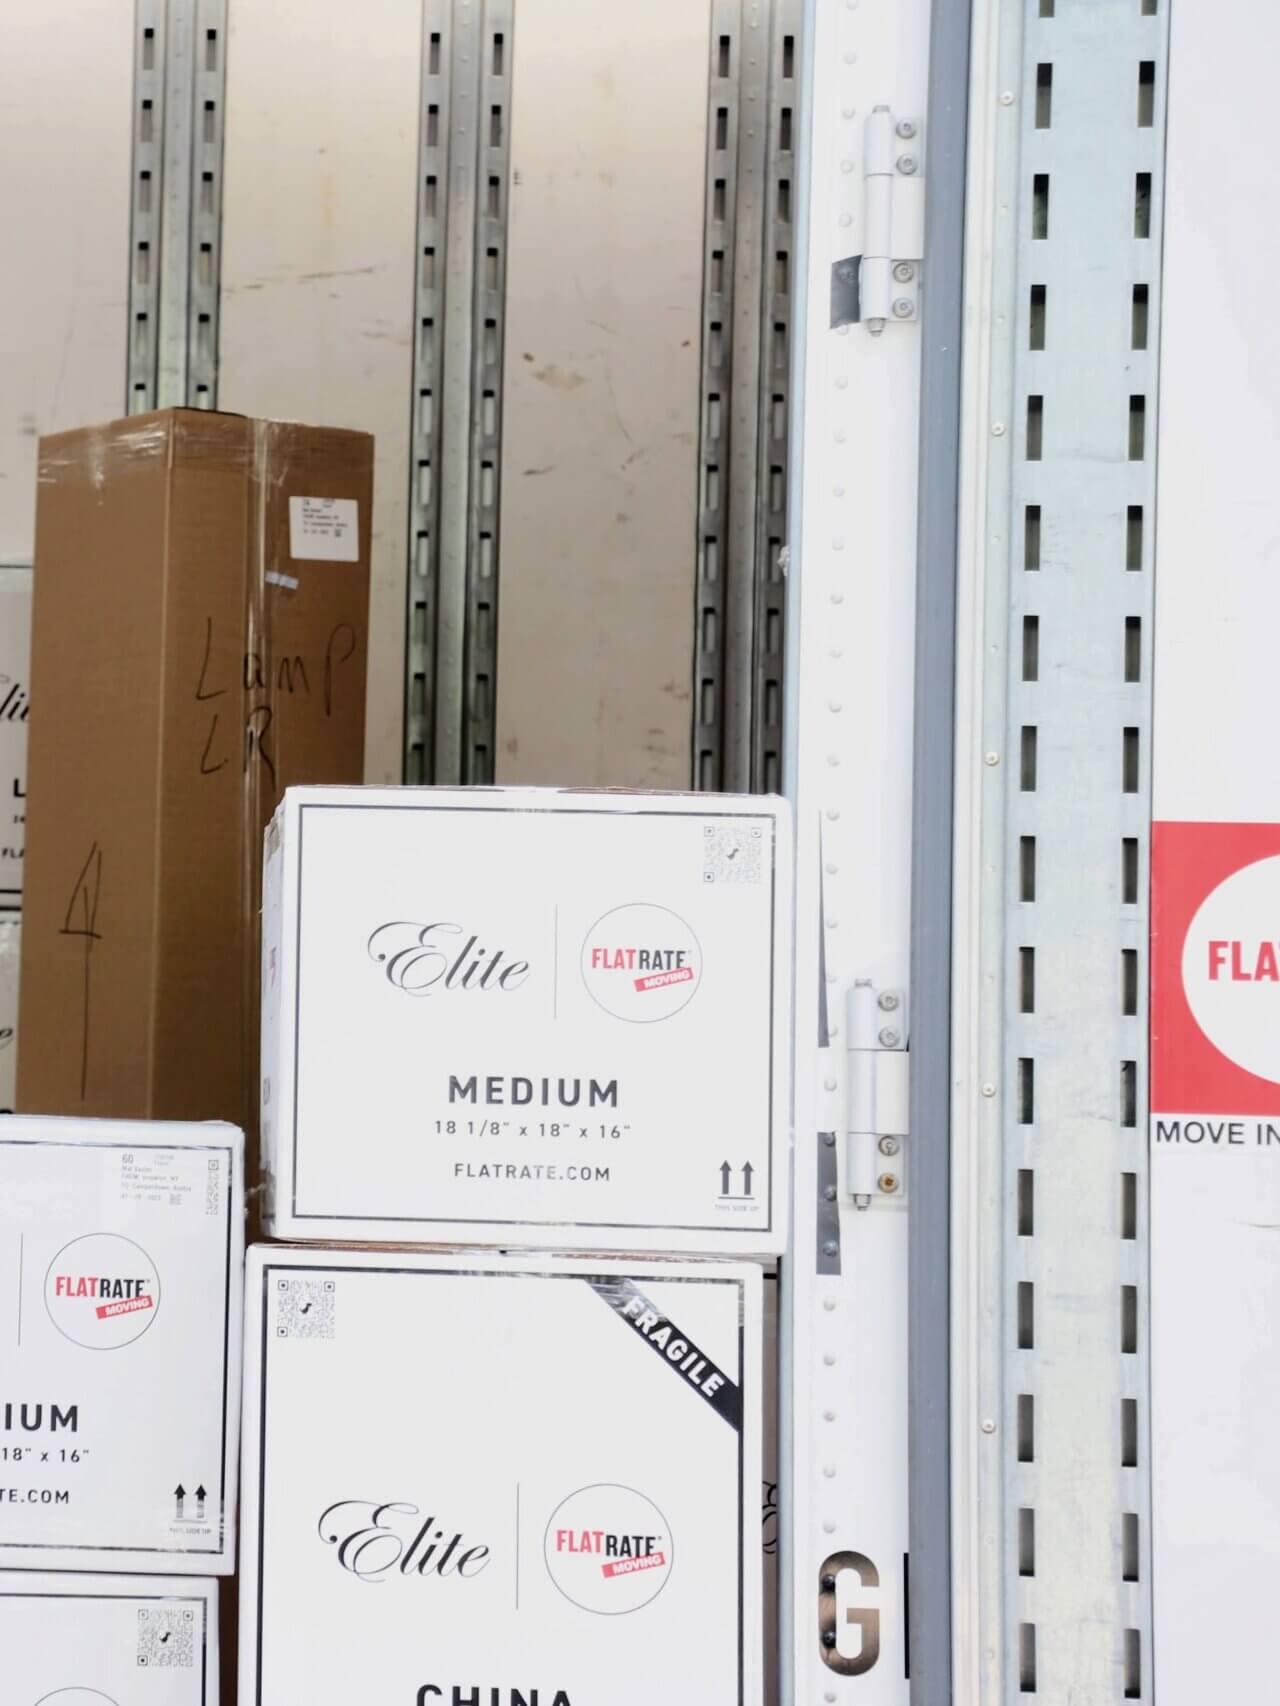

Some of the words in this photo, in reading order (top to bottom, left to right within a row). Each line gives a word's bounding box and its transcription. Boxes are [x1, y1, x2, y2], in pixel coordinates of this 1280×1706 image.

[367, 920, 531, 998] Elite
[591, 947, 687, 971] FLATRATE
[1208, 940, 1280, 983] FLA
[643, 969, 691, 989] MOVING
[448, 1074, 619, 1108] MEDIUM
[435, 1120, 457, 1135] 18
[467, 1119, 510, 1137] 1/8"
[519, 1127, 528, 1137] x
[539, 1122, 570, 1138] 18"
[579, 1128, 588, 1138] x
[599, 1124, 631, 1139] 16"
[1156, 1120, 1246, 1145] MOVE
[454, 1162, 610, 1182] FLATRATE.COM
[55, 1275, 145, 1299] FLATRATE
[105, 1297, 150, 1316] MOVING
[621, 1296, 725, 1398] FRAGILE
[1, 1447, 32, 1462] 18"
[40, 1451, 49, 1462] x
[59, 1448, 90, 1464] 16"
[318, 1500, 493, 1584] Elite
[556, 1529, 657, 1558] FLATRATE
[611, 1555, 663, 1575] MOVING
